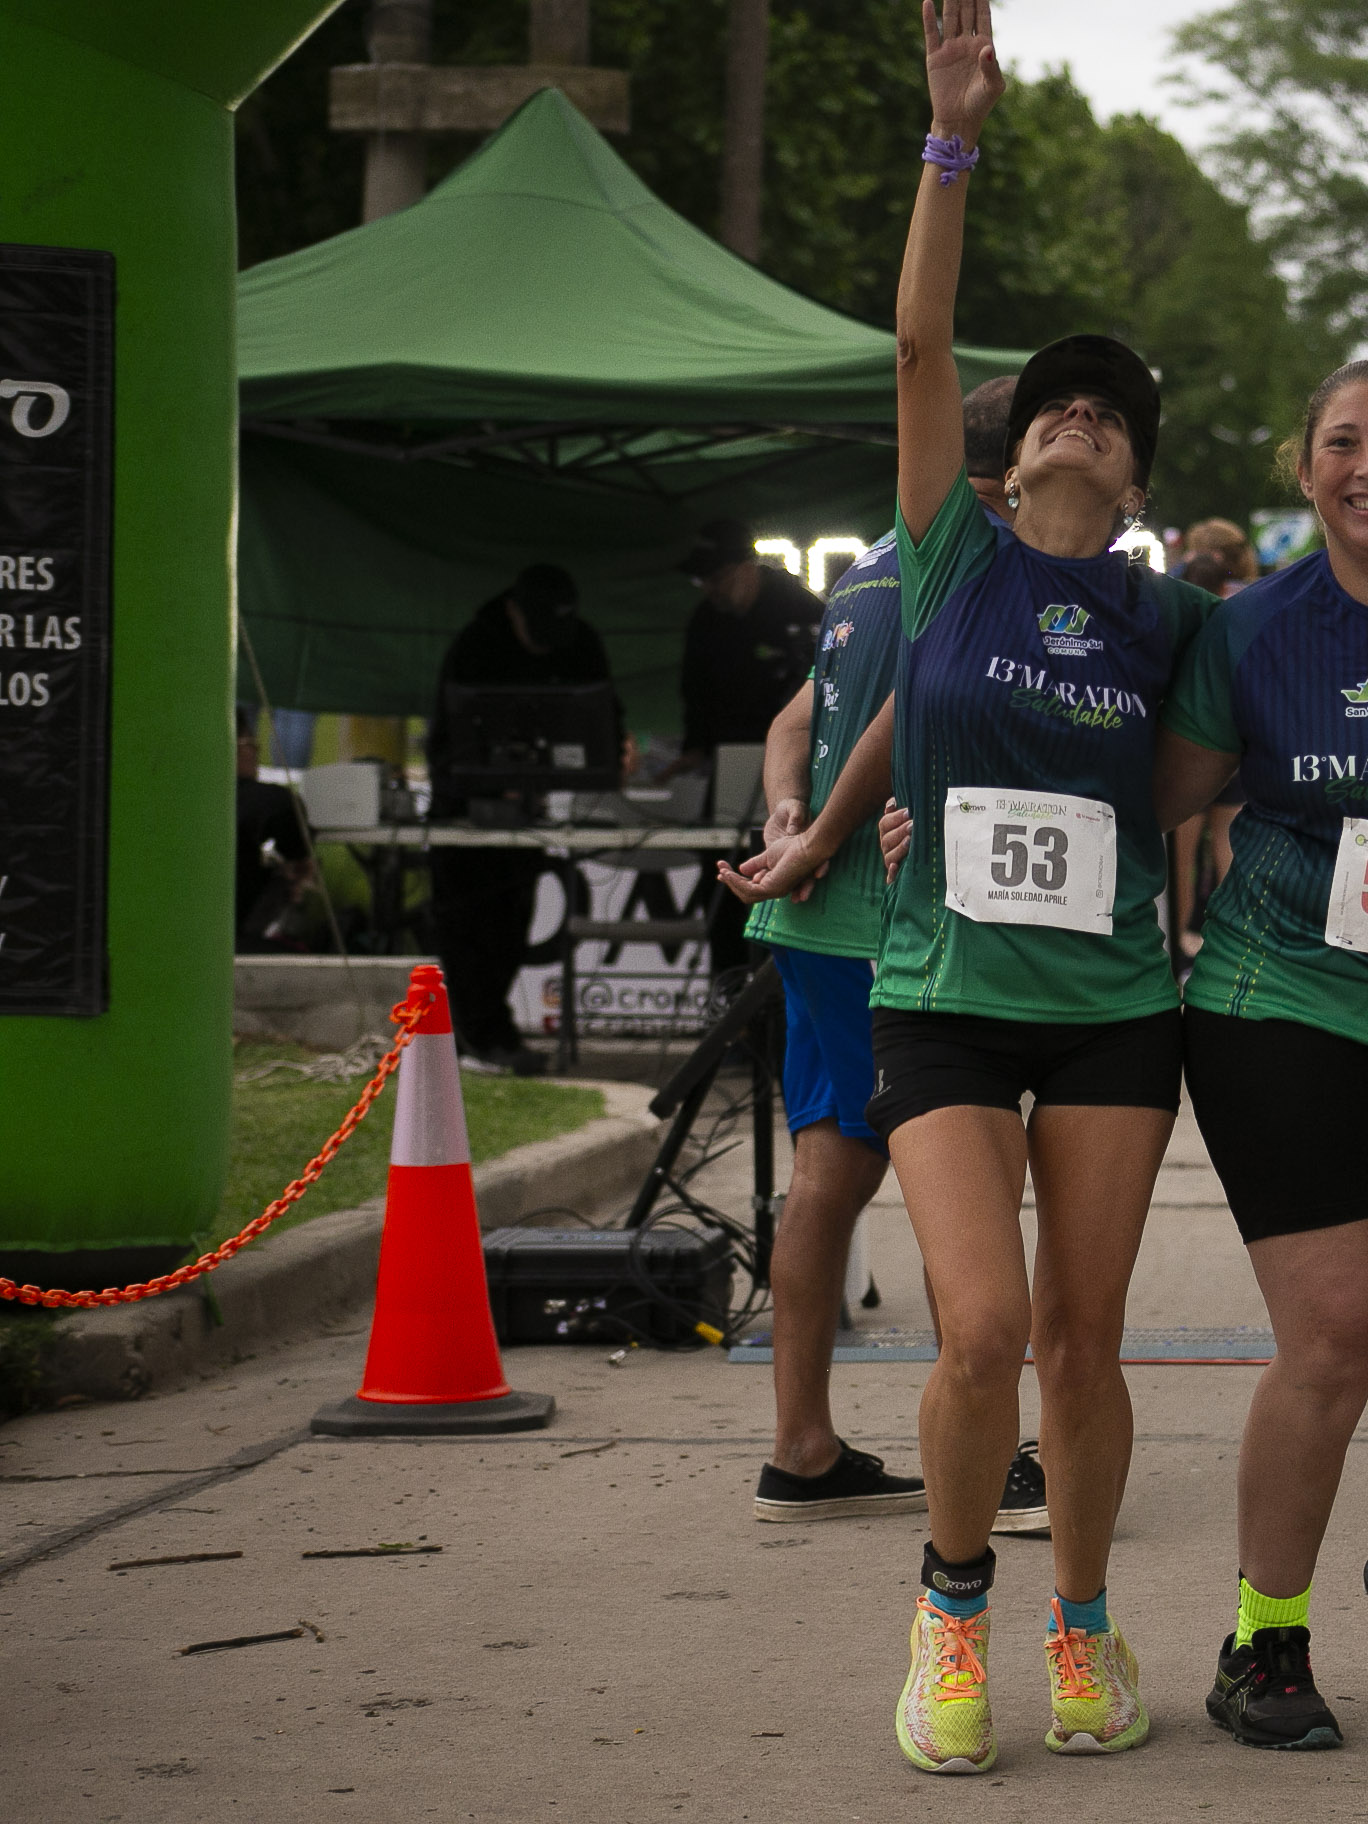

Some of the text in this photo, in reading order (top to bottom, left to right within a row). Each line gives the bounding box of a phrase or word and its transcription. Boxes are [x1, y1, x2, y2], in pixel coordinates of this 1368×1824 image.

[25, 614, 81, 650] LAS
[1047, 647, 1087, 656] COMUNA
[1087, 639, 1103, 650] Su
[1010, 689, 1123, 730] Saludable
[1345, 706, 1367, 717] San
[990, 823, 1069, 891] 53
[988, 889, 1068, 906] MARÍA SOLEDAD APRILE
